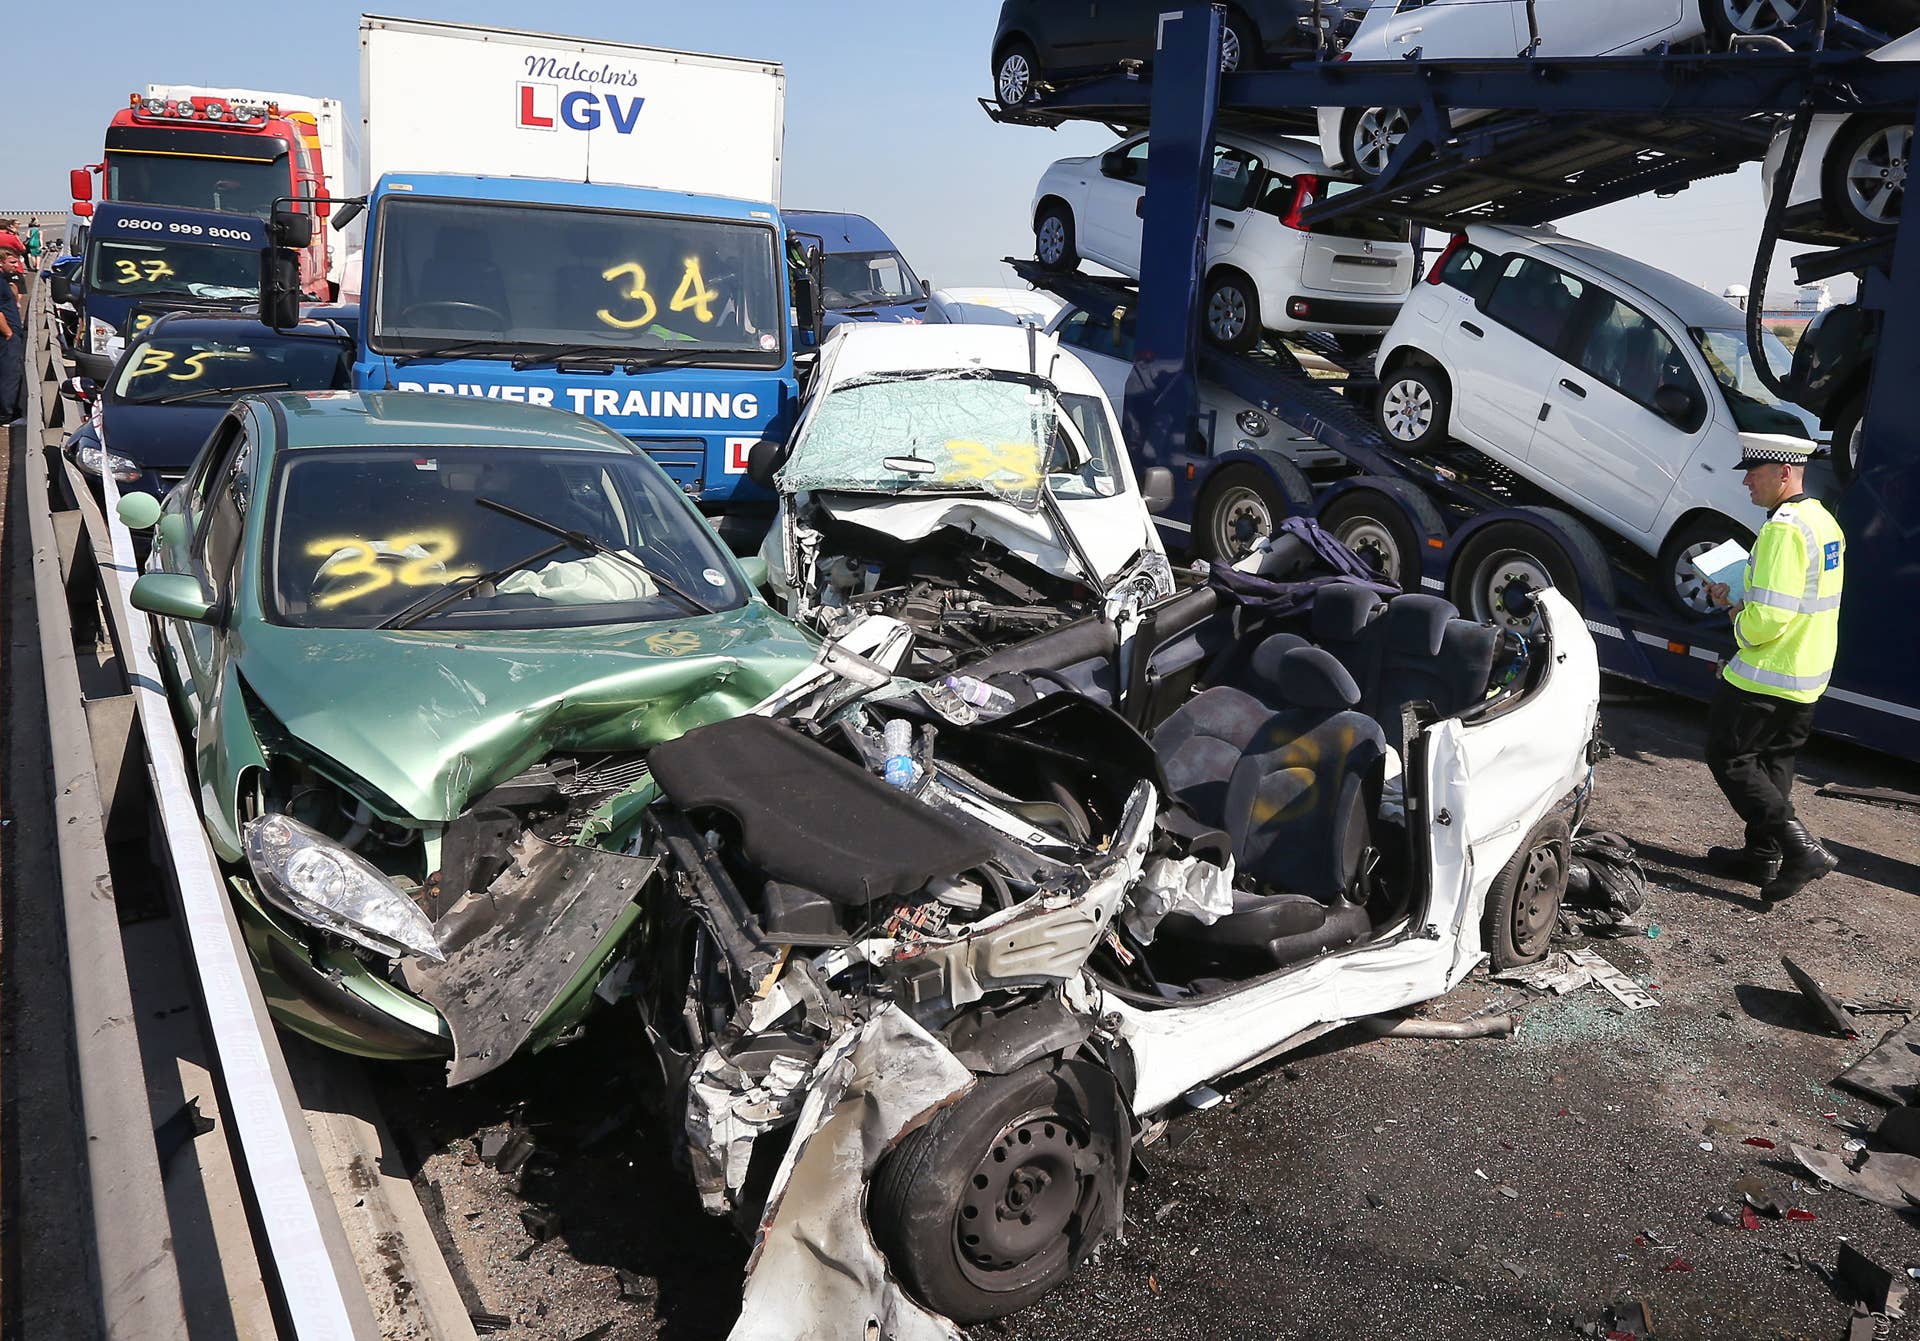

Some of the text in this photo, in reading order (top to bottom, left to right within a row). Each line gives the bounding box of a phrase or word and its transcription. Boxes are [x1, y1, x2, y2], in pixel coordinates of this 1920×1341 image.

[524, 55, 638, 87] Malcolm's
[521, 85, 645, 134] LGV
[117, 218, 251, 241] 0800 999 8000
[115, 259, 175, 284] 37
[596, 257, 719, 329] 34
[132, 348, 257, 381] 35
[566, 388, 758, 420] TRAINING
[732, 443, 750, 468] L
[305, 529, 481, 609] 32
